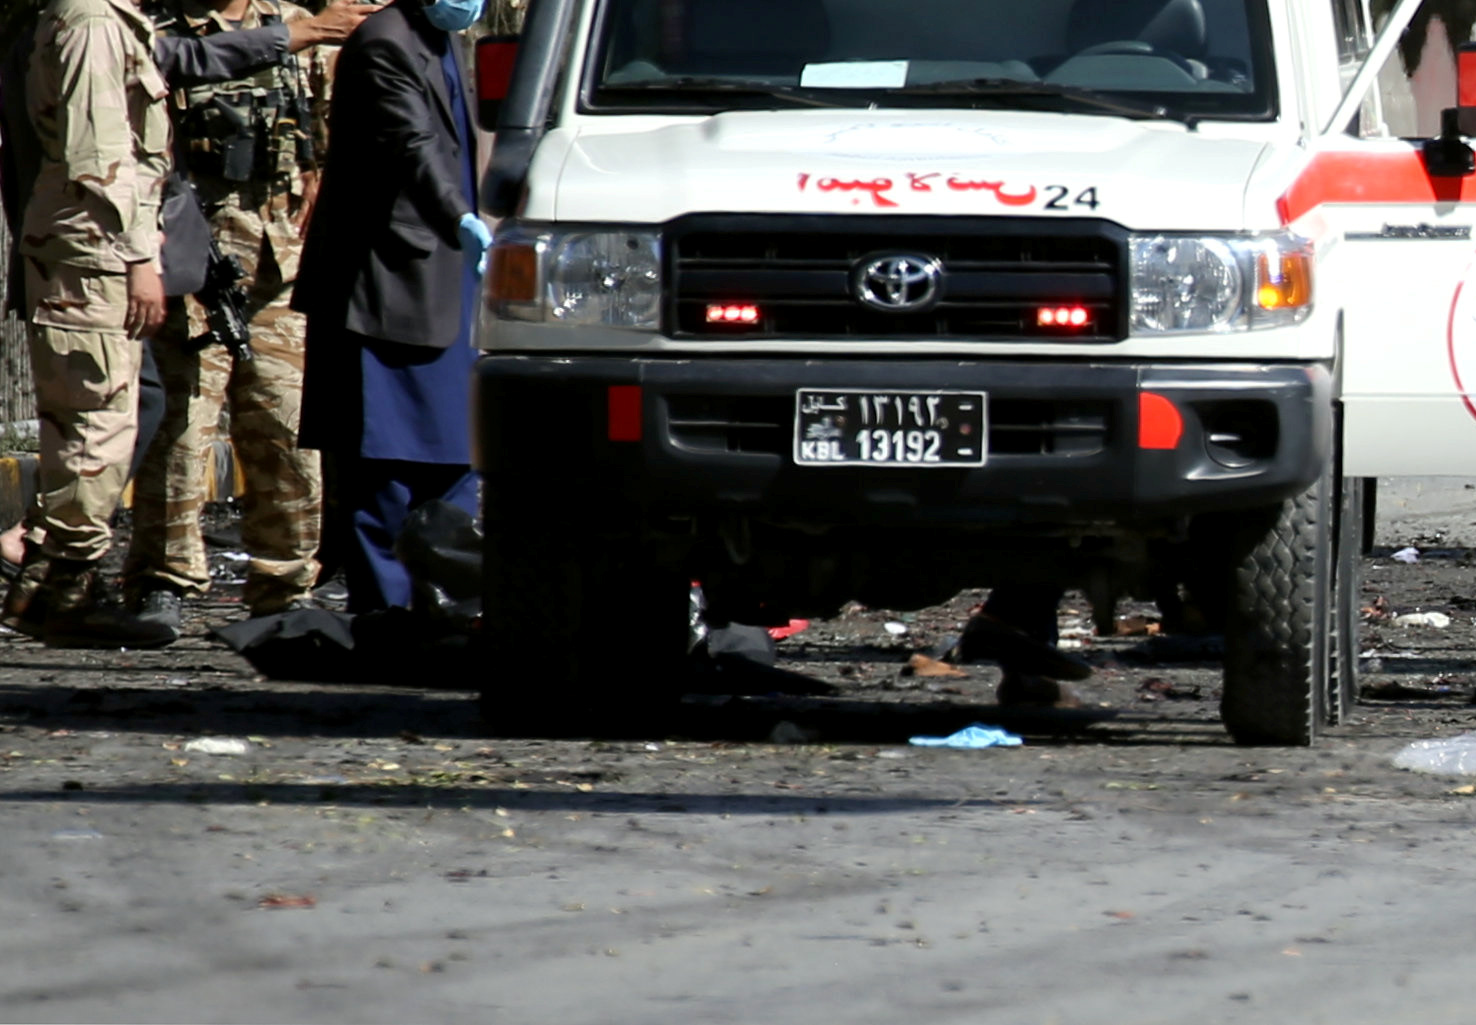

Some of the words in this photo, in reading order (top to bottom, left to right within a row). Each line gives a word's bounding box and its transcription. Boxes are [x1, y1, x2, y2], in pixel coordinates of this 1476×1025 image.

[1043, 184, 1100, 211] 24
[801, 440, 847, 461] KBL
[855, 429, 941, 462] 13192
